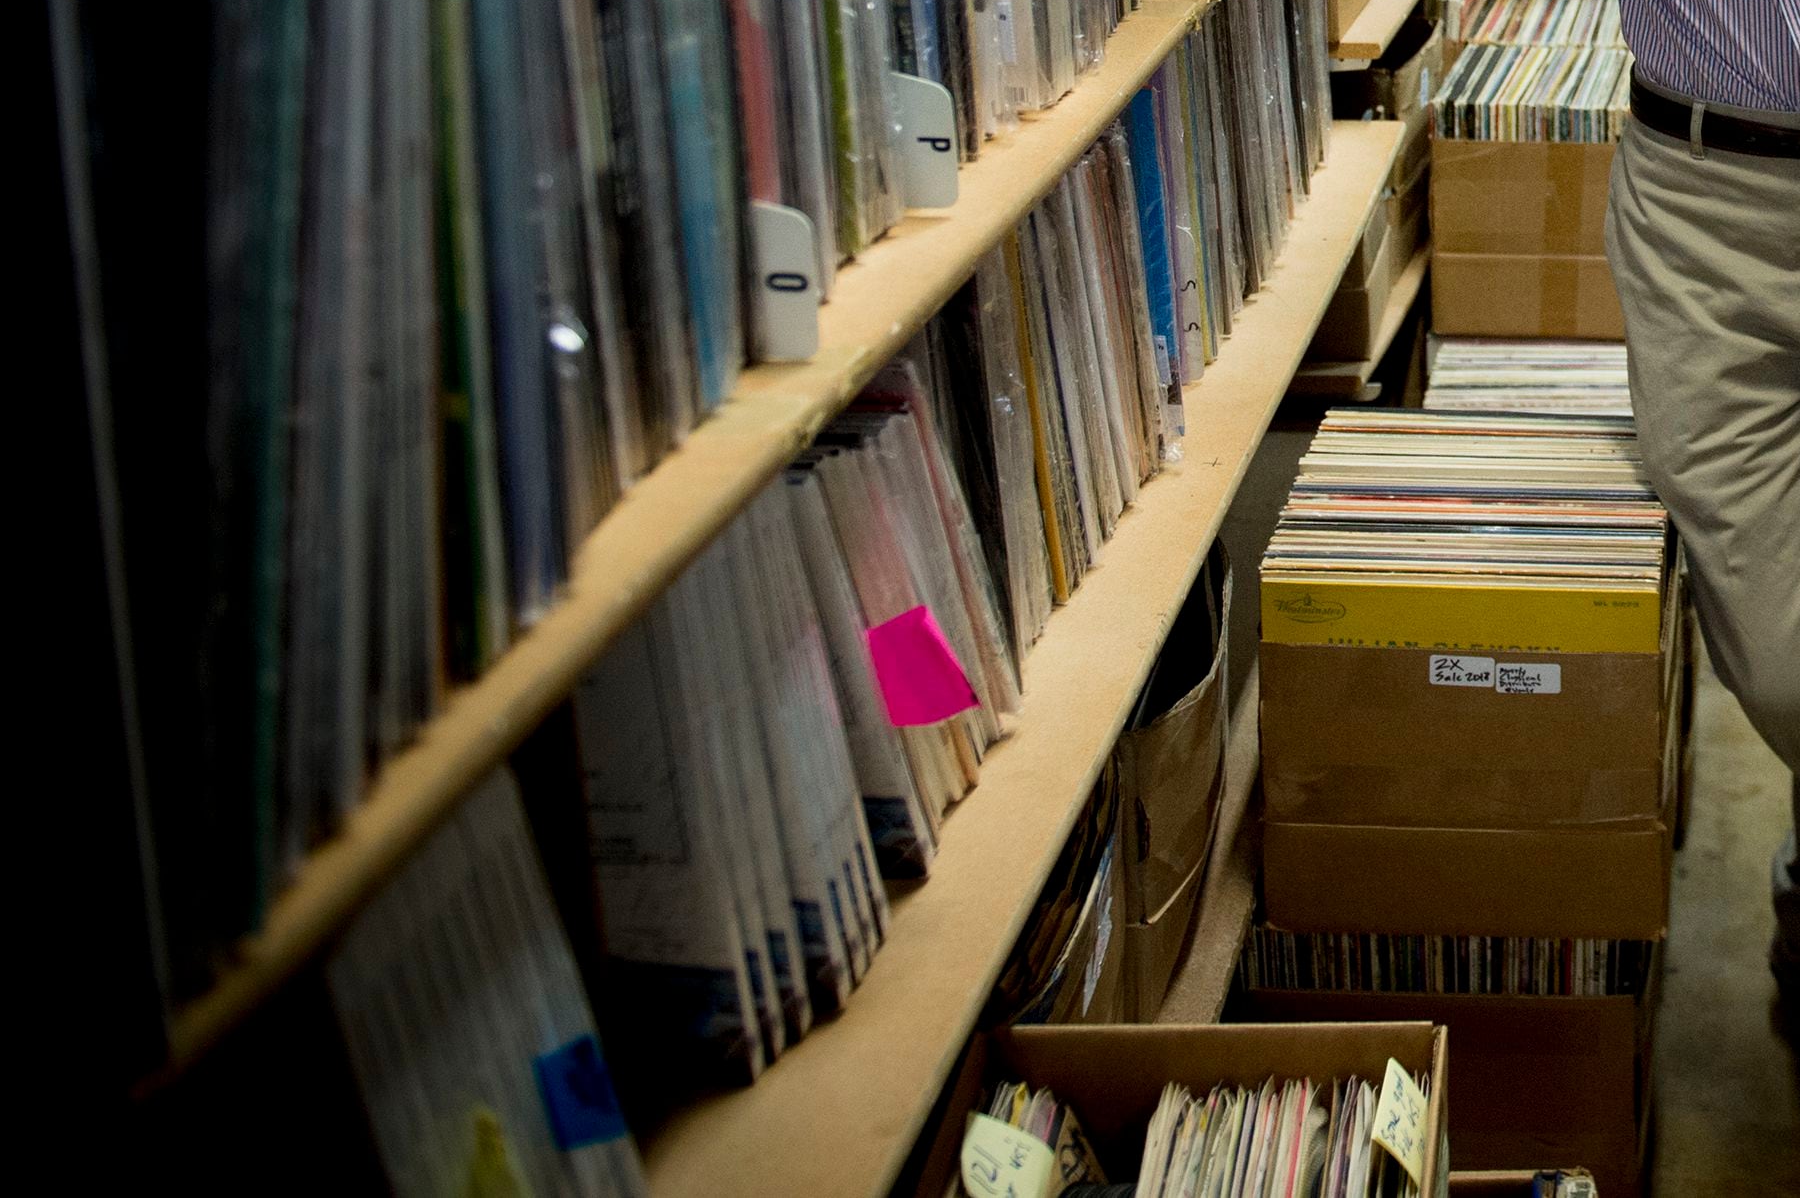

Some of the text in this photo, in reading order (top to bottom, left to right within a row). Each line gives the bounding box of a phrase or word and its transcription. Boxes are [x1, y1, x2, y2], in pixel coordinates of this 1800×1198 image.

[917, 137, 951, 152] P
[766, 273, 808, 292] O
[1434, 658, 1465, 671] 2X
[1435, 671, 1463, 683] Sale
